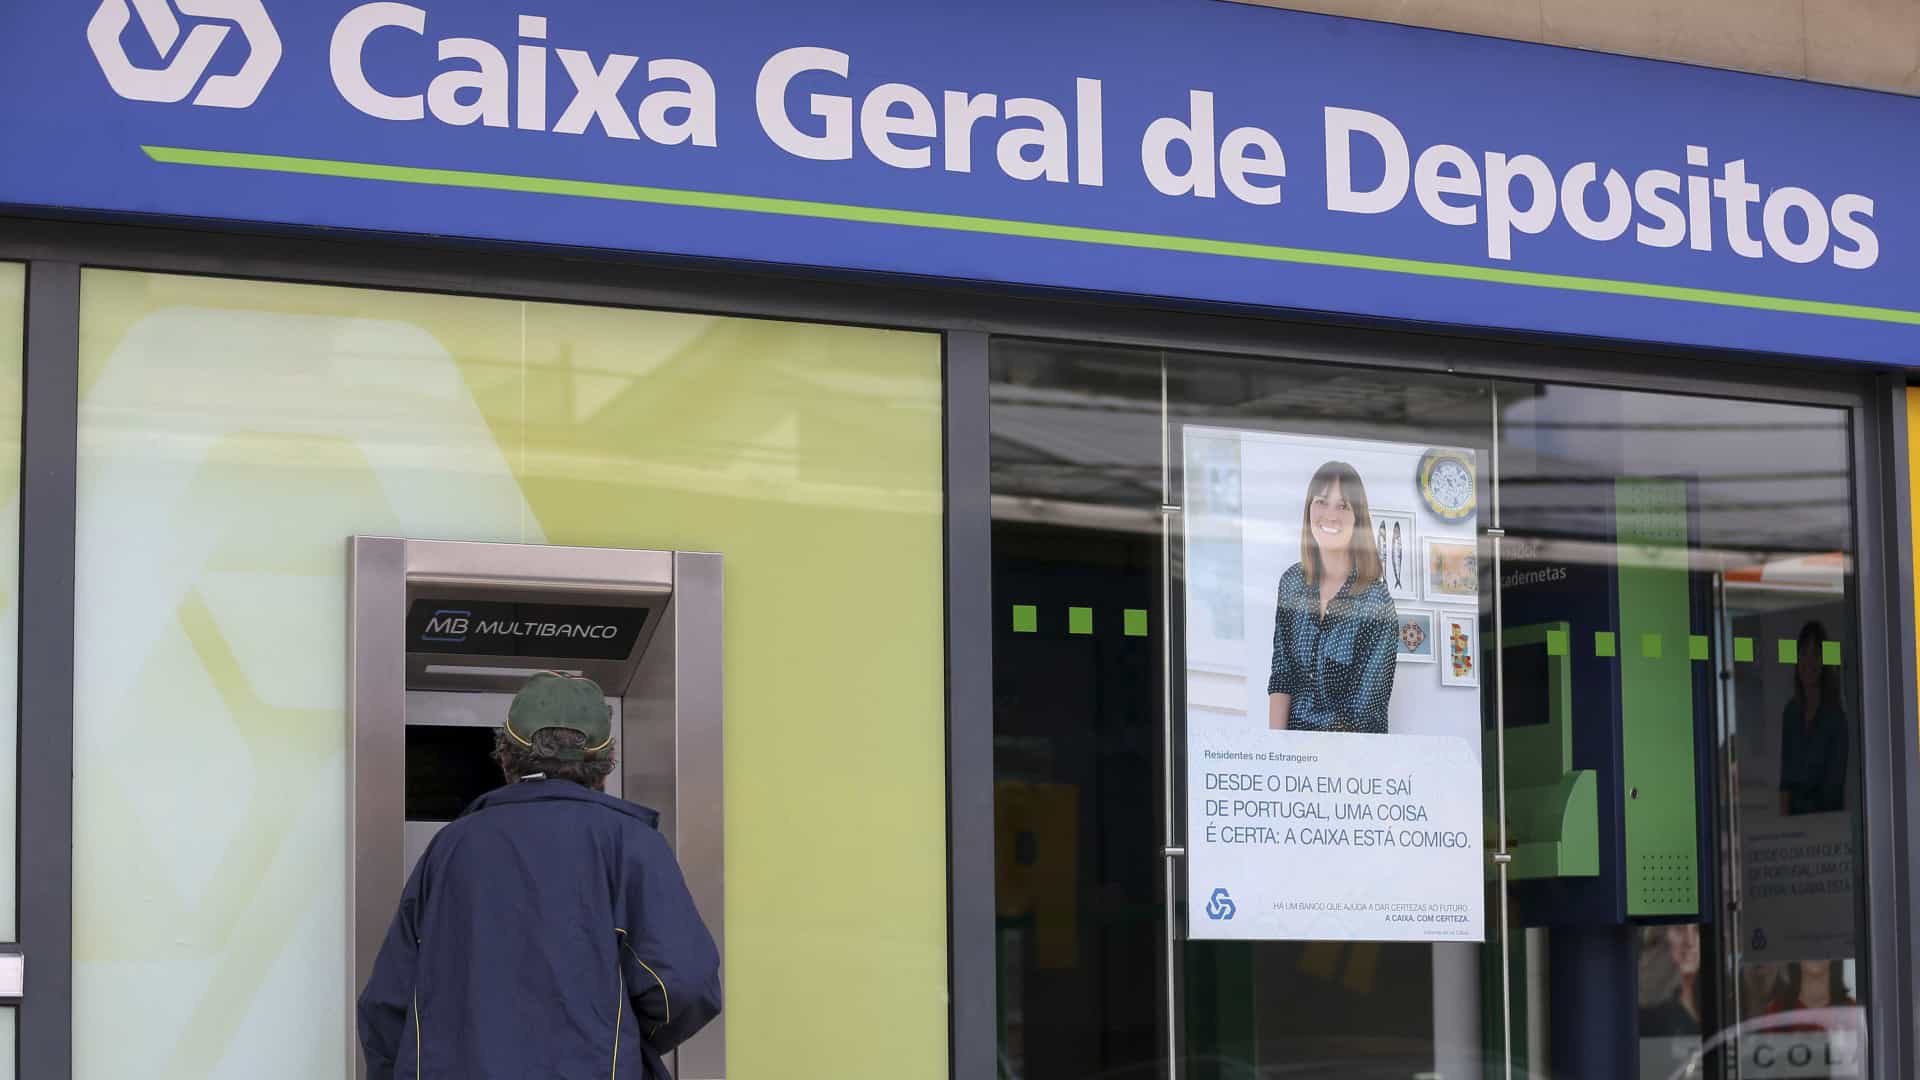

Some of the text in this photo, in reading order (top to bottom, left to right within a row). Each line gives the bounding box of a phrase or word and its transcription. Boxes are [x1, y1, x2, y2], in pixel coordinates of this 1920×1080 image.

[329, 1, 717, 148] Caixa
[755, 46, 1103, 187] Geral
[1141, 89, 1286, 206] de
[425, 616, 618, 639] MB MULTIBANCO
[1204, 750, 1318, 763] Residentes no Estrangeiro
[1206, 773, 1413, 796] DESDE O DIA EM QUE SAÍ
[1206, 800, 1428, 822] DE PORTUGAL, UMA COISA
[1206, 822, 1472, 849] É CERTA: A CAIXA ESTÁ COMIGO.
[1298, 903, 1325, 911] BANCO
[1326, 903, 1343, 912] QUE
[1391, 904, 1427, 912] CERTEZAS
[1417, 914, 1434, 922] COM
[1435, 915, 1470, 923] CERTEZA.
